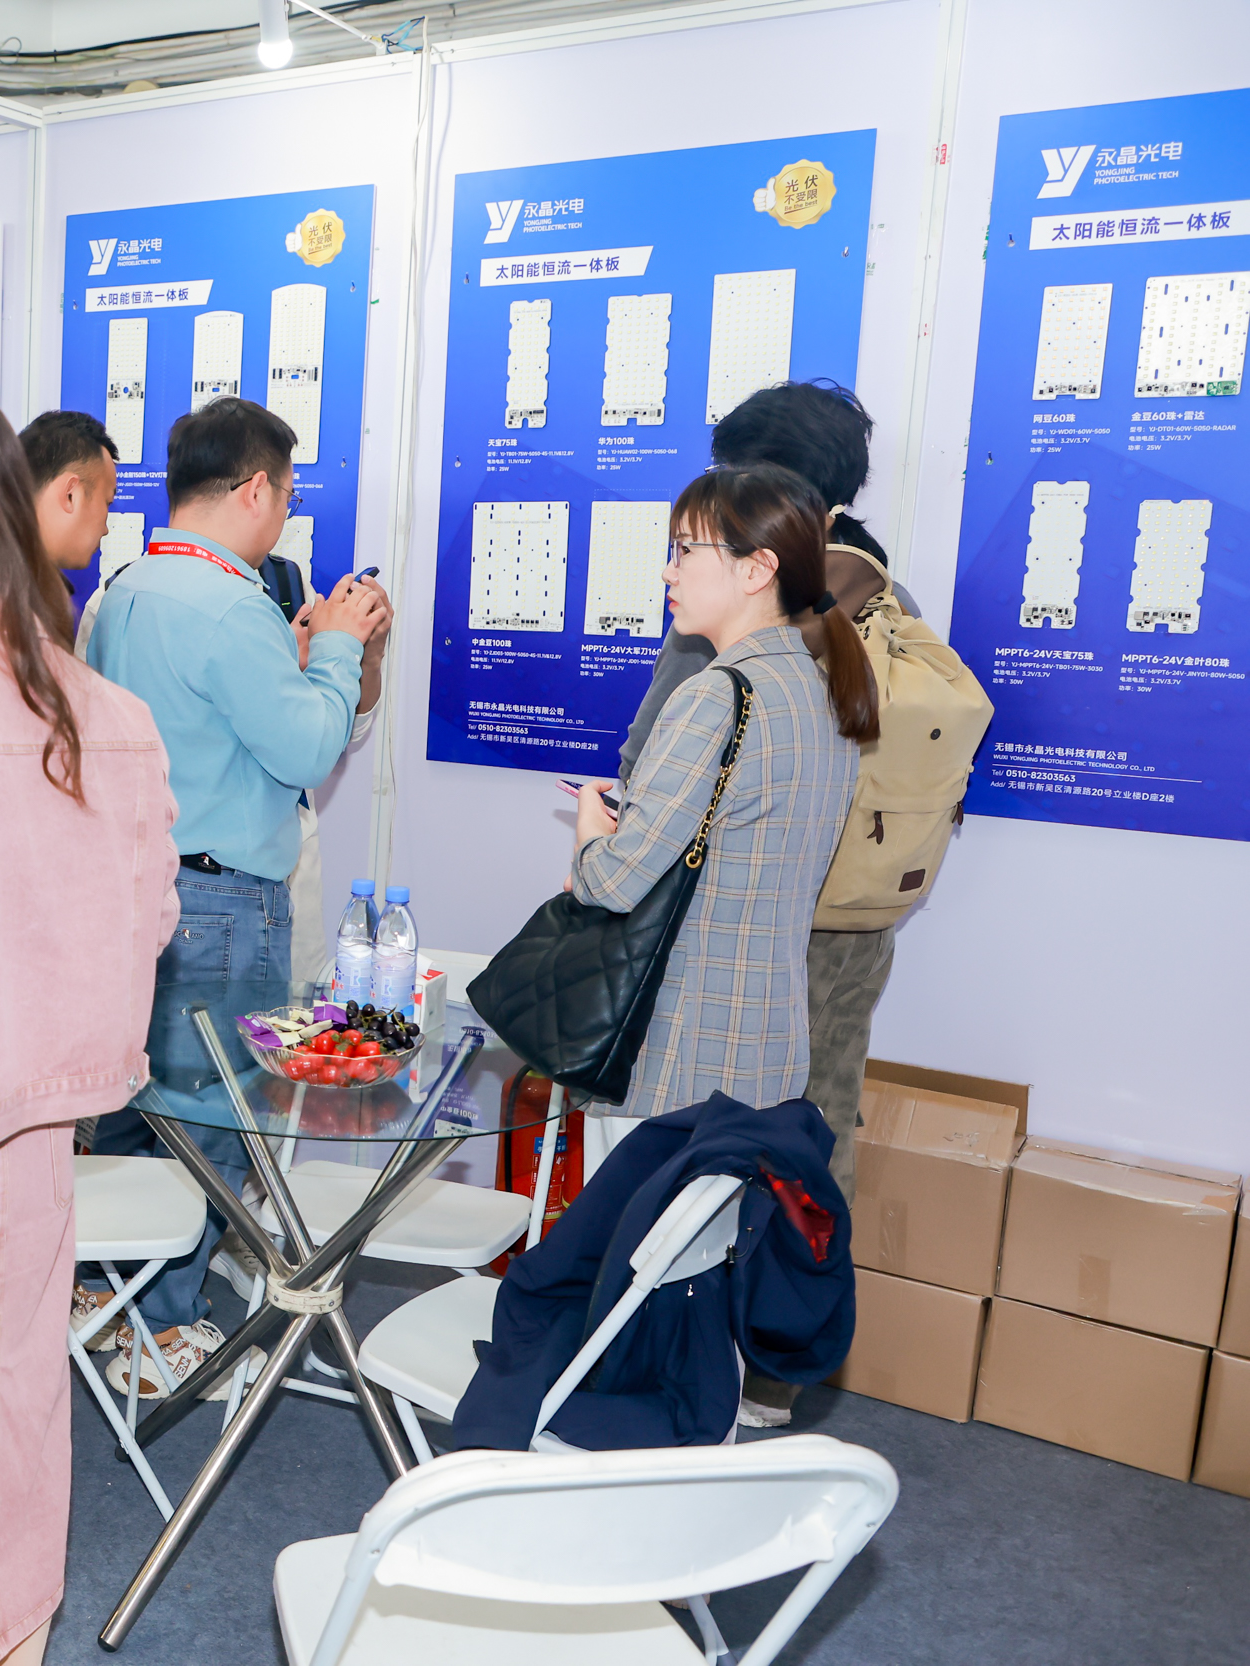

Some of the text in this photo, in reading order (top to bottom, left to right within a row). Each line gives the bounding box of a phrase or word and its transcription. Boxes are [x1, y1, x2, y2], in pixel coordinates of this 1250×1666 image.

[1095, 141, 1183, 167] 永晶光电
[1093, 170, 1179, 185] PHOTOELECTRIC TECH
[1094, 167, 1135, 177] YONGJING
[784, 173, 820, 194] 光伏
[784, 188, 819, 206] 不受限
[524, 198, 585, 218] 永晶光电
[784, 204, 793, 212] Be
[803, 200, 818, 208] best
[308, 221, 333, 236] 光伏
[523, 219, 552, 228] YONGJING
[523, 223, 567, 233] PHOTOELECTRIC
[1051, 210, 1232, 242] 太阳能恒流一体板
[117, 237, 163, 254] 永晶光电
[308, 233, 333, 247] 不受限
[495, 256, 621, 280] 太阳能恒流一体板
[96, 287, 189, 306] 太阳能恒流一体板
[1131, 410, 1205, 422] 金豆60珠+雷达
[488, 438, 518, 447] 天宝75珠
[598, 436, 635, 446] 华为100珠
[471, 637, 512, 648] 中金豆100珠
[581, 644, 662, 656] MPPT6-24V大军刀160
[995, 647, 1095, 661] MPPT6-24V天宝75珠
[1121, 653, 1230, 668] MPPT6-24V金叶80珠
[469, 701, 565, 716] 无锡市永晶光电科技有限公司
[478, 723, 529, 735] 0510-82303563
[994, 742, 1128, 762] 无锡市永晶光电科技有限公司
[1009, 755, 1039, 763] YONGJING
[1039, 757, 1087, 767] PHOTOELECTRIC
[1088, 761, 1129, 771] TECHNOLOGY
[1006, 769, 1076, 783] 0510-82303563
